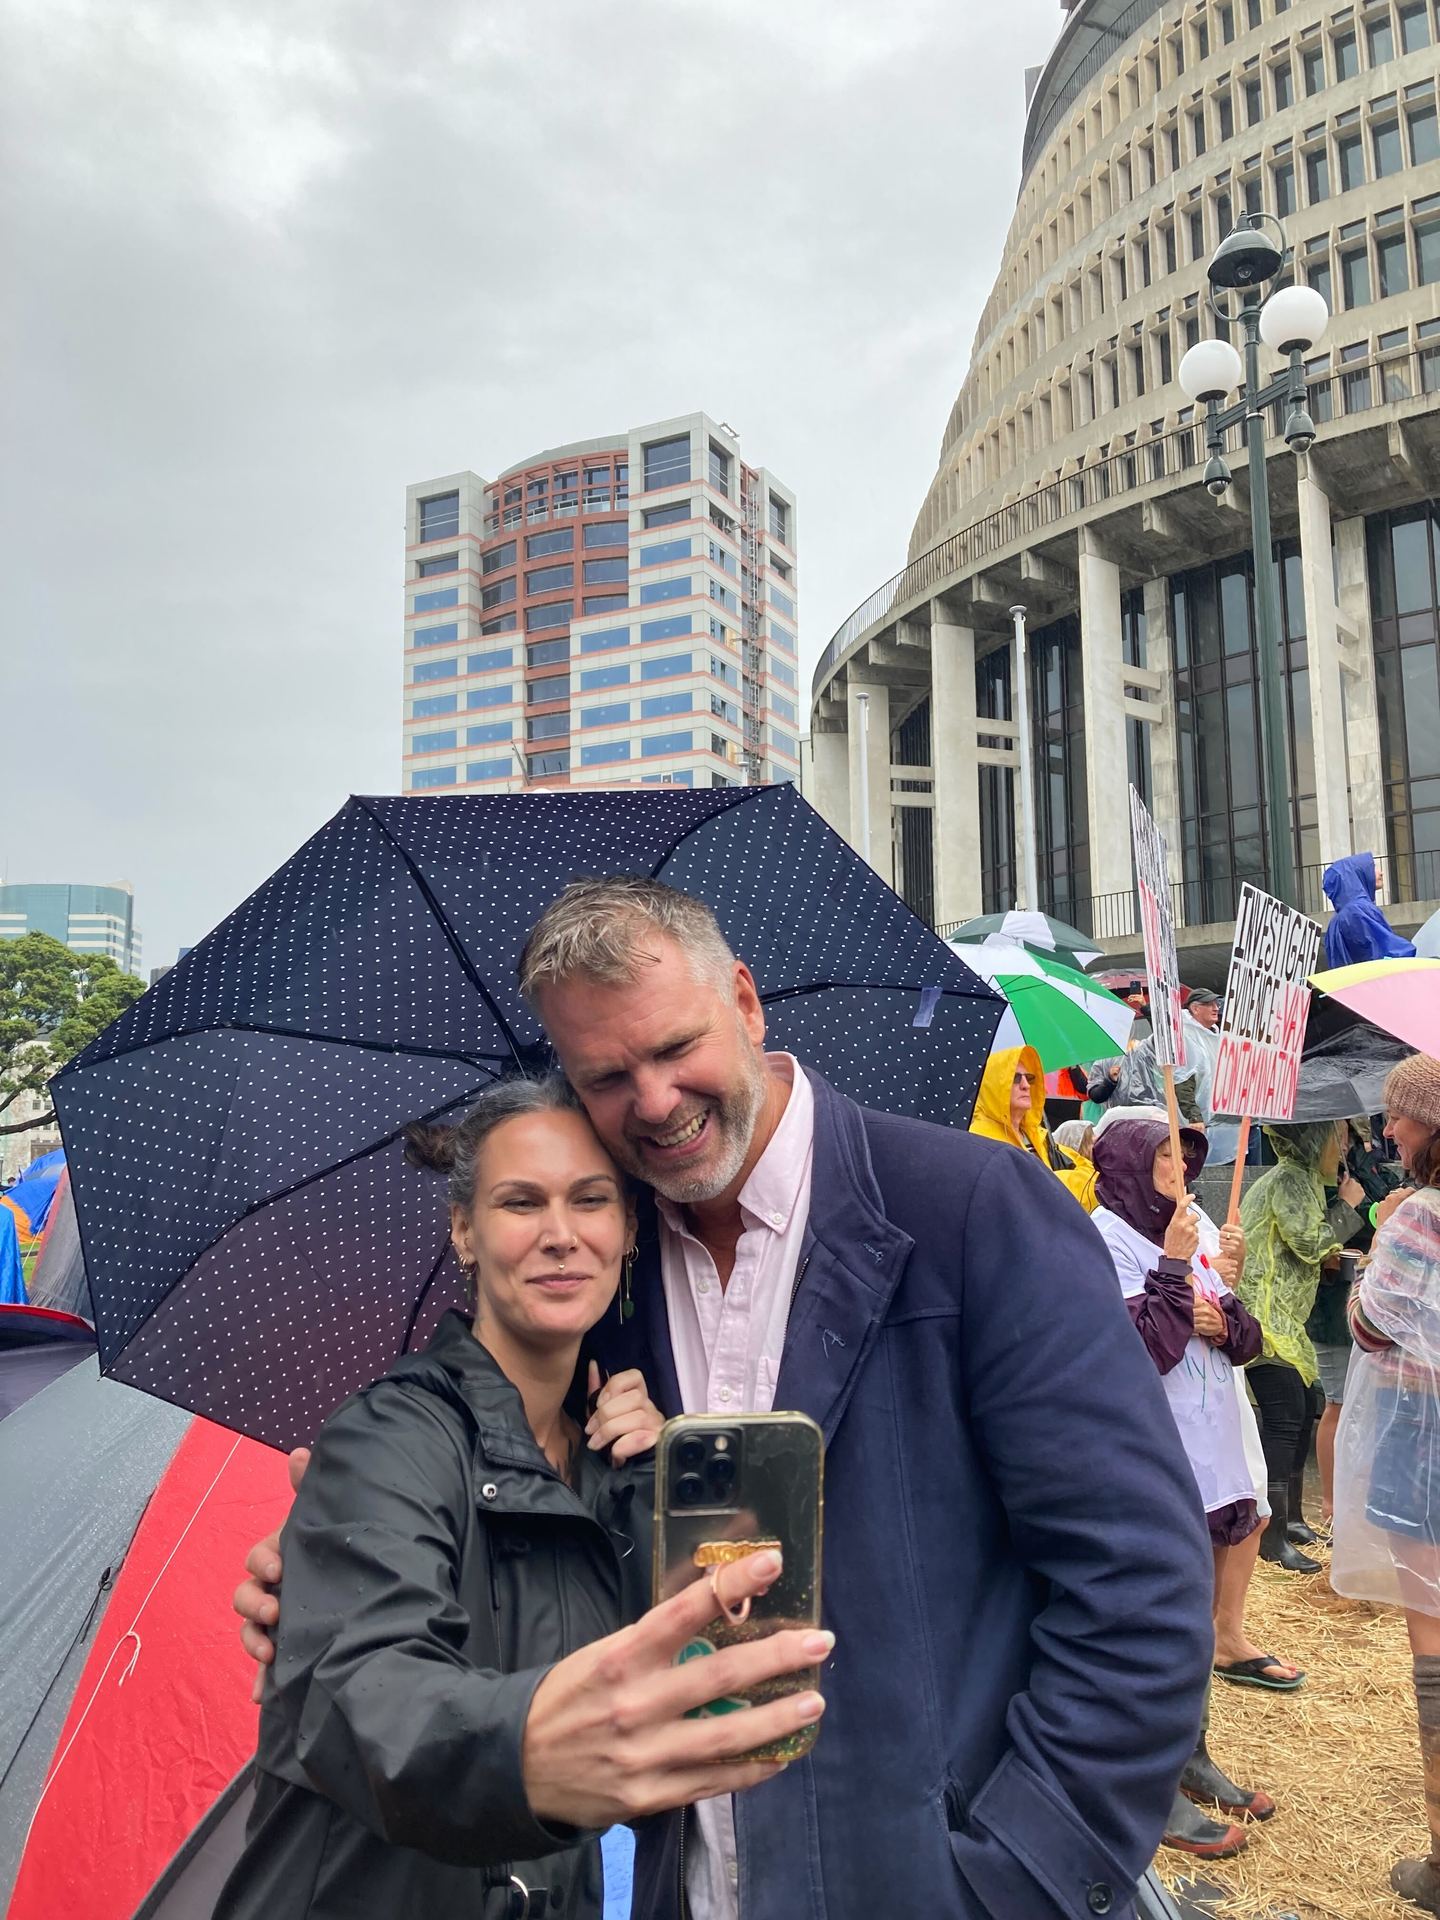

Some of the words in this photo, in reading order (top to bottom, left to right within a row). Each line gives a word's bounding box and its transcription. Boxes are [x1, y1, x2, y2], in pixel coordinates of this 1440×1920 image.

[1234, 886, 1322, 990] INVESTIGATE
[1223, 961, 1280, 1044] EVIDENCE
[1282, 983, 1312, 1053] VAX
[1212, 1035, 1297, 1120] CONTAMINATION
